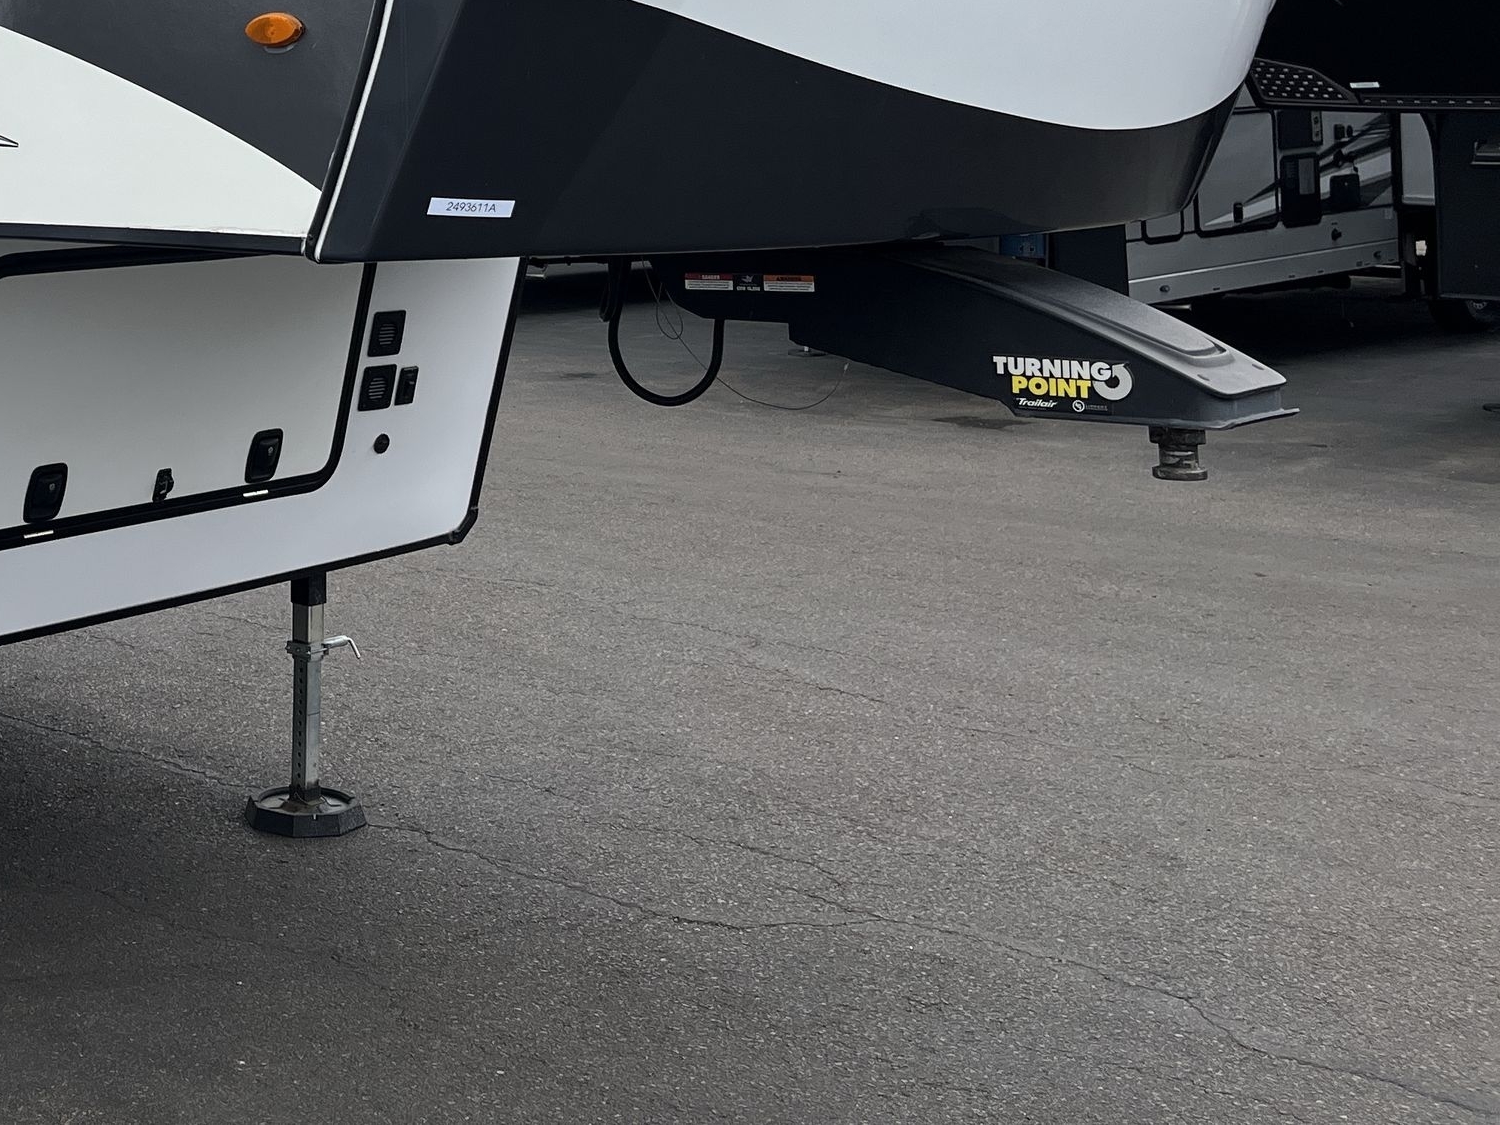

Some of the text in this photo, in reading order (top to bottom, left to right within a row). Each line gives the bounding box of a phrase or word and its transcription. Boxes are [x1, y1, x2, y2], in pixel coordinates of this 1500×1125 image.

[445, 201, 497, 213] 2493611A
[993, 356, 1112, 381] TURNING
[1011, 375, 1092, 399] POINT
[1015, 397, 1058, 408] Trailair
